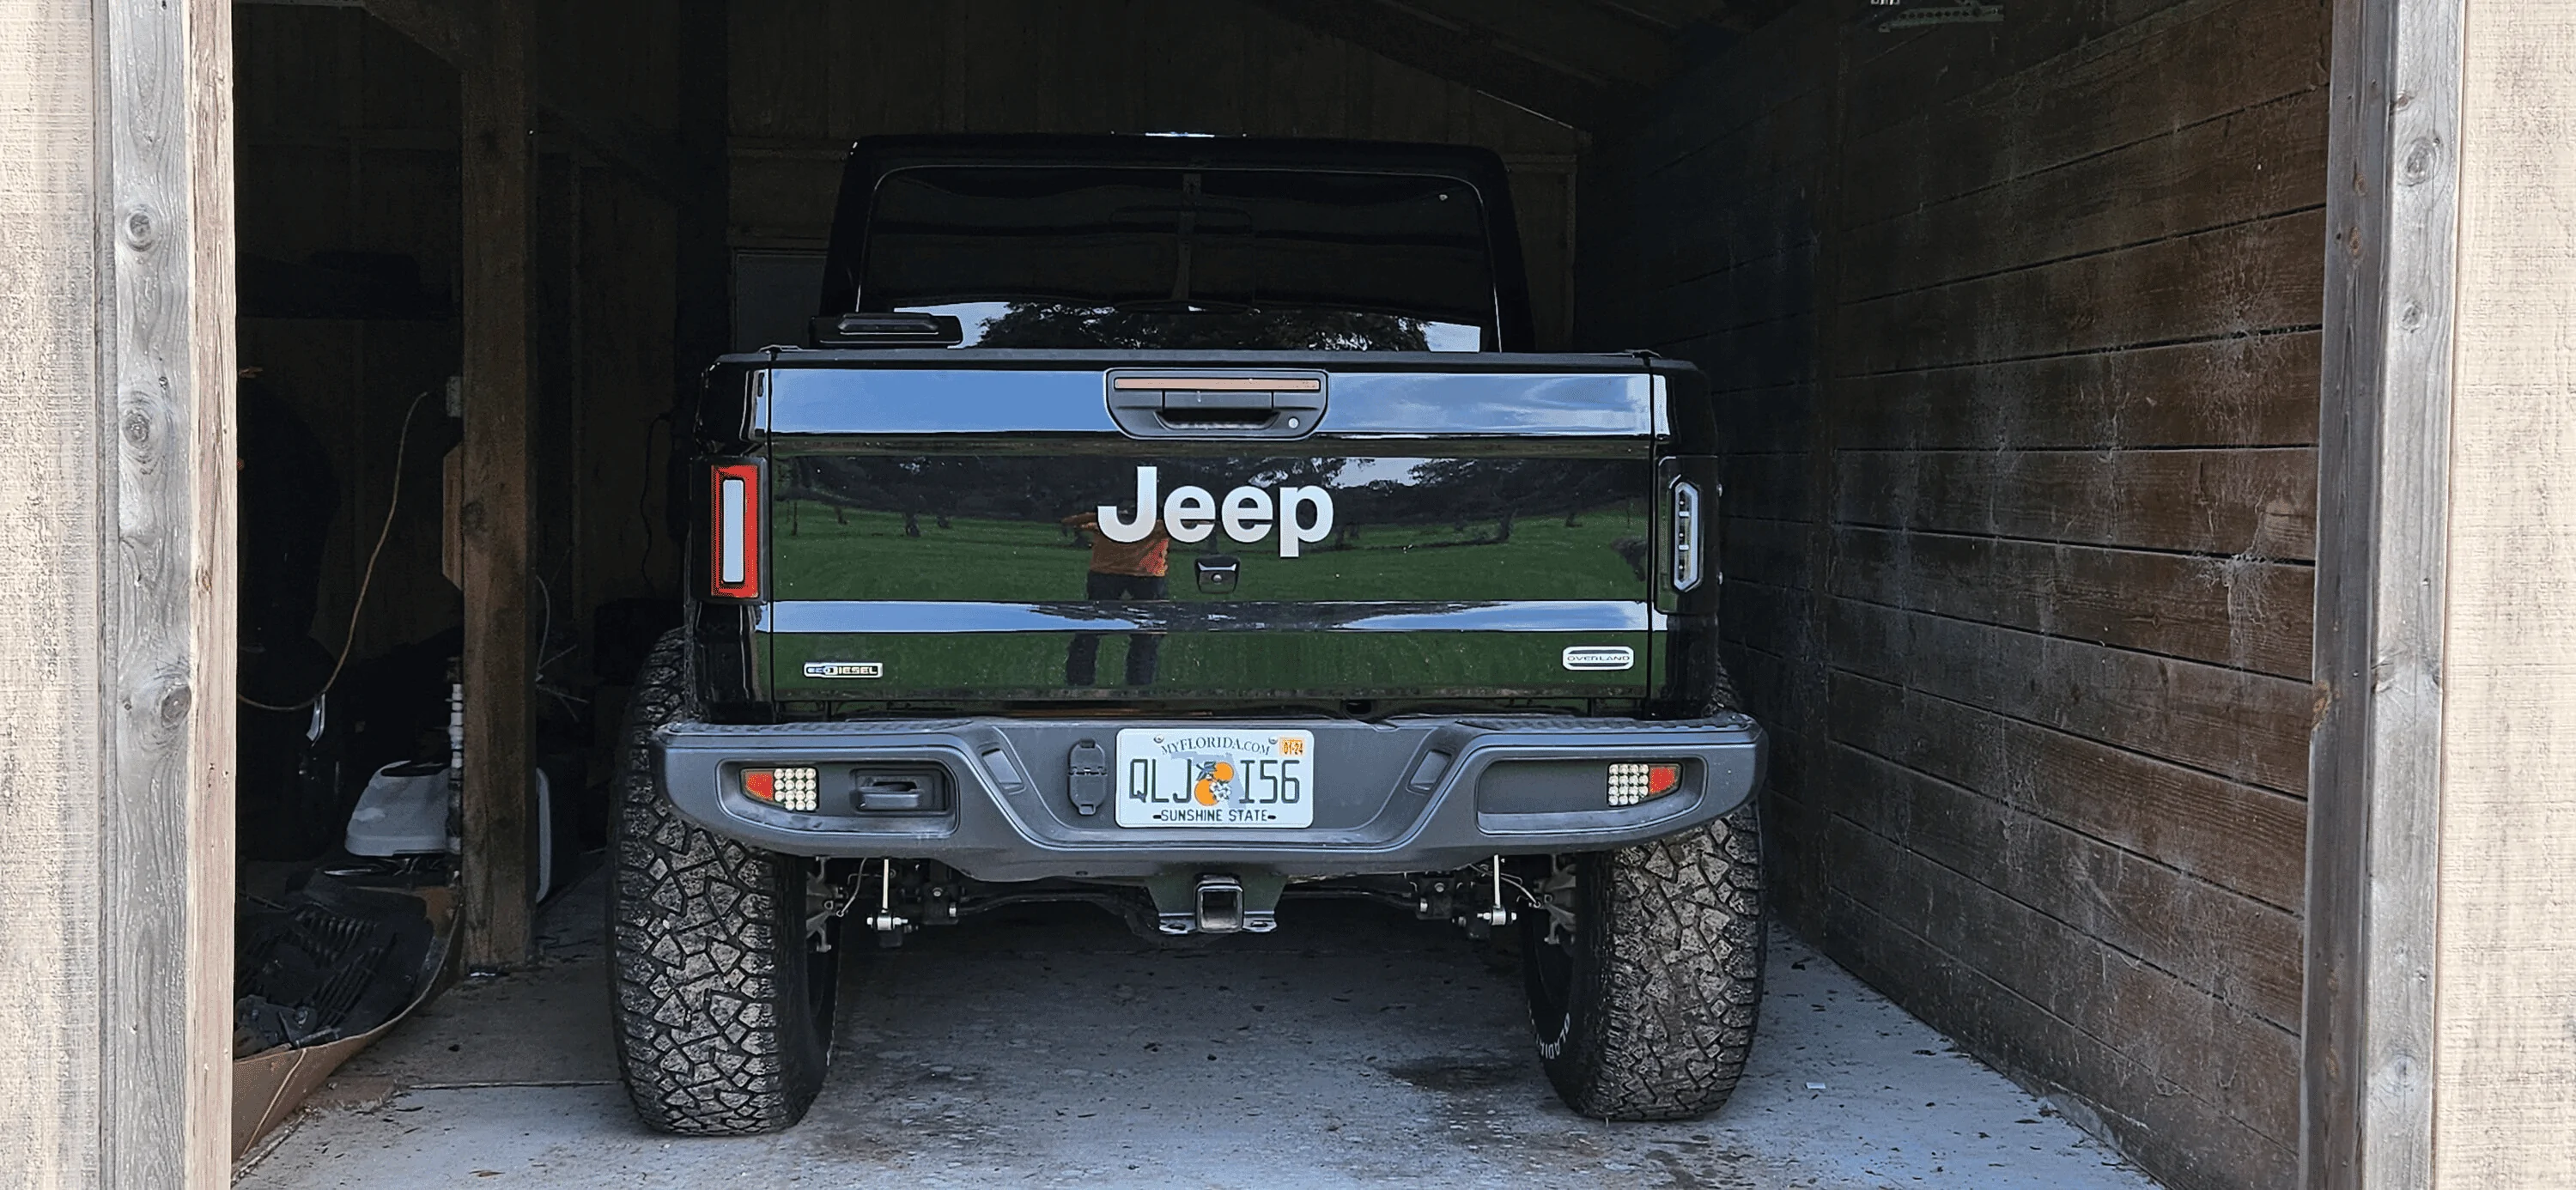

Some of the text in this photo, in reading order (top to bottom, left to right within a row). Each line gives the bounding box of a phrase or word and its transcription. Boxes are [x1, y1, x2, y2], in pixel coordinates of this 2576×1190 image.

[1097, 466, 1334, 557] Jeep
[1161, 737, 1270, 756] MYFLORIDA.COM
[1129, 758, 1300, 804] QLJ I56
[1161, 810, 1268, 822] SUNSHINE STATE
